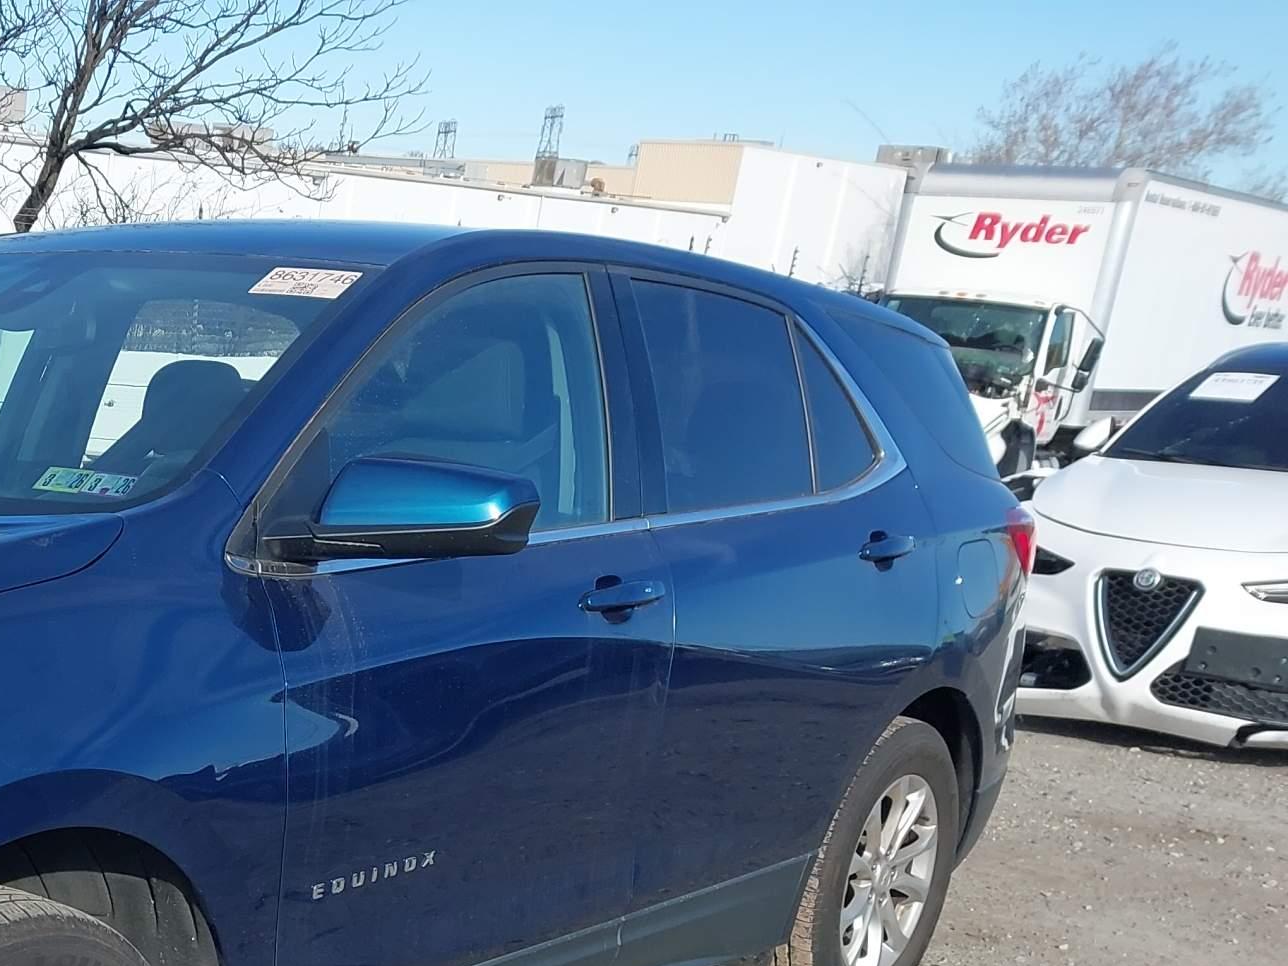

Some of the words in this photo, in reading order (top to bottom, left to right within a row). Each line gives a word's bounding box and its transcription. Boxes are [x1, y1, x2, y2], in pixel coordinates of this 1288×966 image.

[968, 211, 1091, 249] Ryder
[269, 270, 358, 285] 8631746
[1237, 251, 1288, 310] Ryder
[42, 473, 56, 487] 3
[88, 477, 104, 491] 3
[115, 478, 136, 495] 26
[311, 850, 436, 900] EQUINOX
